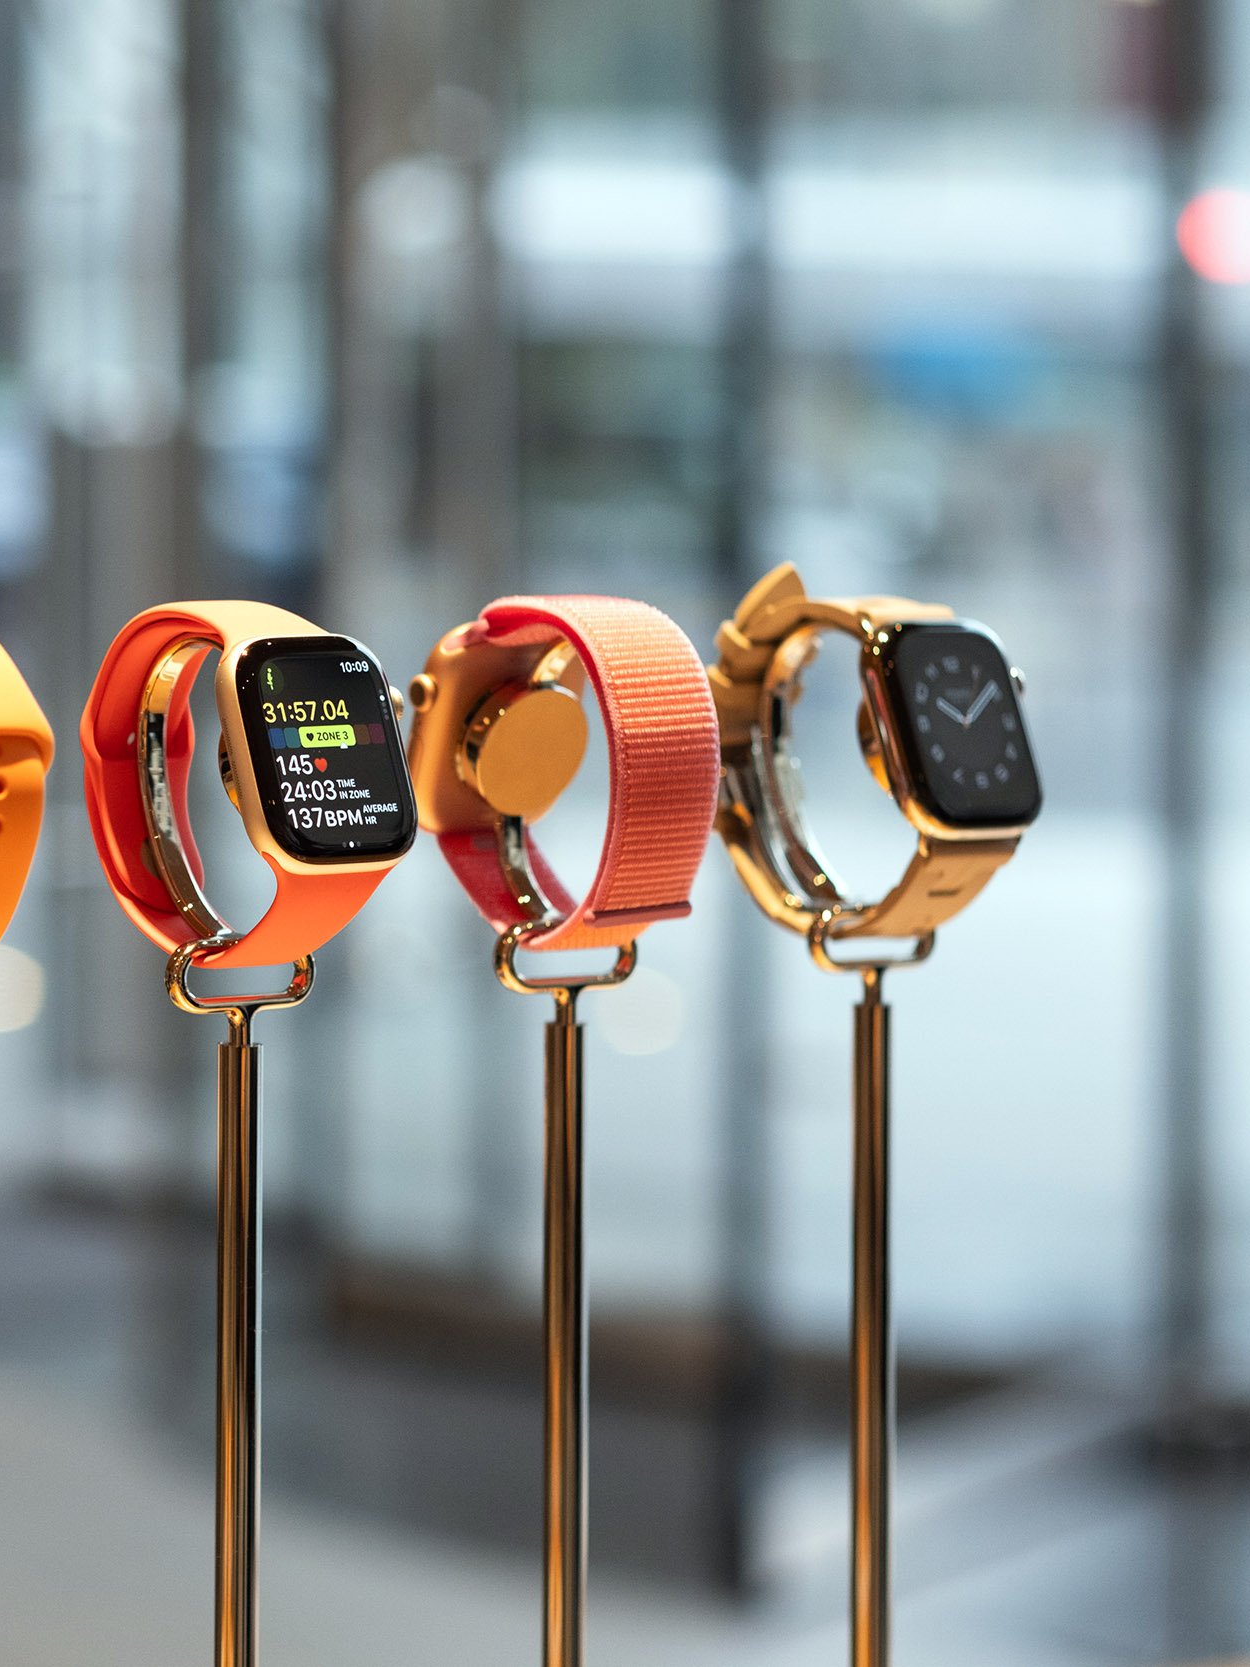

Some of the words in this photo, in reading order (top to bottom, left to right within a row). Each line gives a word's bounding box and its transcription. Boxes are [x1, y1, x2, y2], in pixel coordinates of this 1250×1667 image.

[339, 661, 369, 673] 10:09
[263, 699, 350, 724] 31:57.04
[317, 731, 342, 741] ZONE
[342, 731, 350, 740] 3
[276, 754, 313, 776] 145
[336, 779, 356, 789] TIME
[280, 780, 337, 803] 24:03
[339, 791, 348, 799] IN
[349, 790, 371, 799] ZONE
[363, 803, 398, 814] AVERAGE
[365, 815, 377, 825] HR
